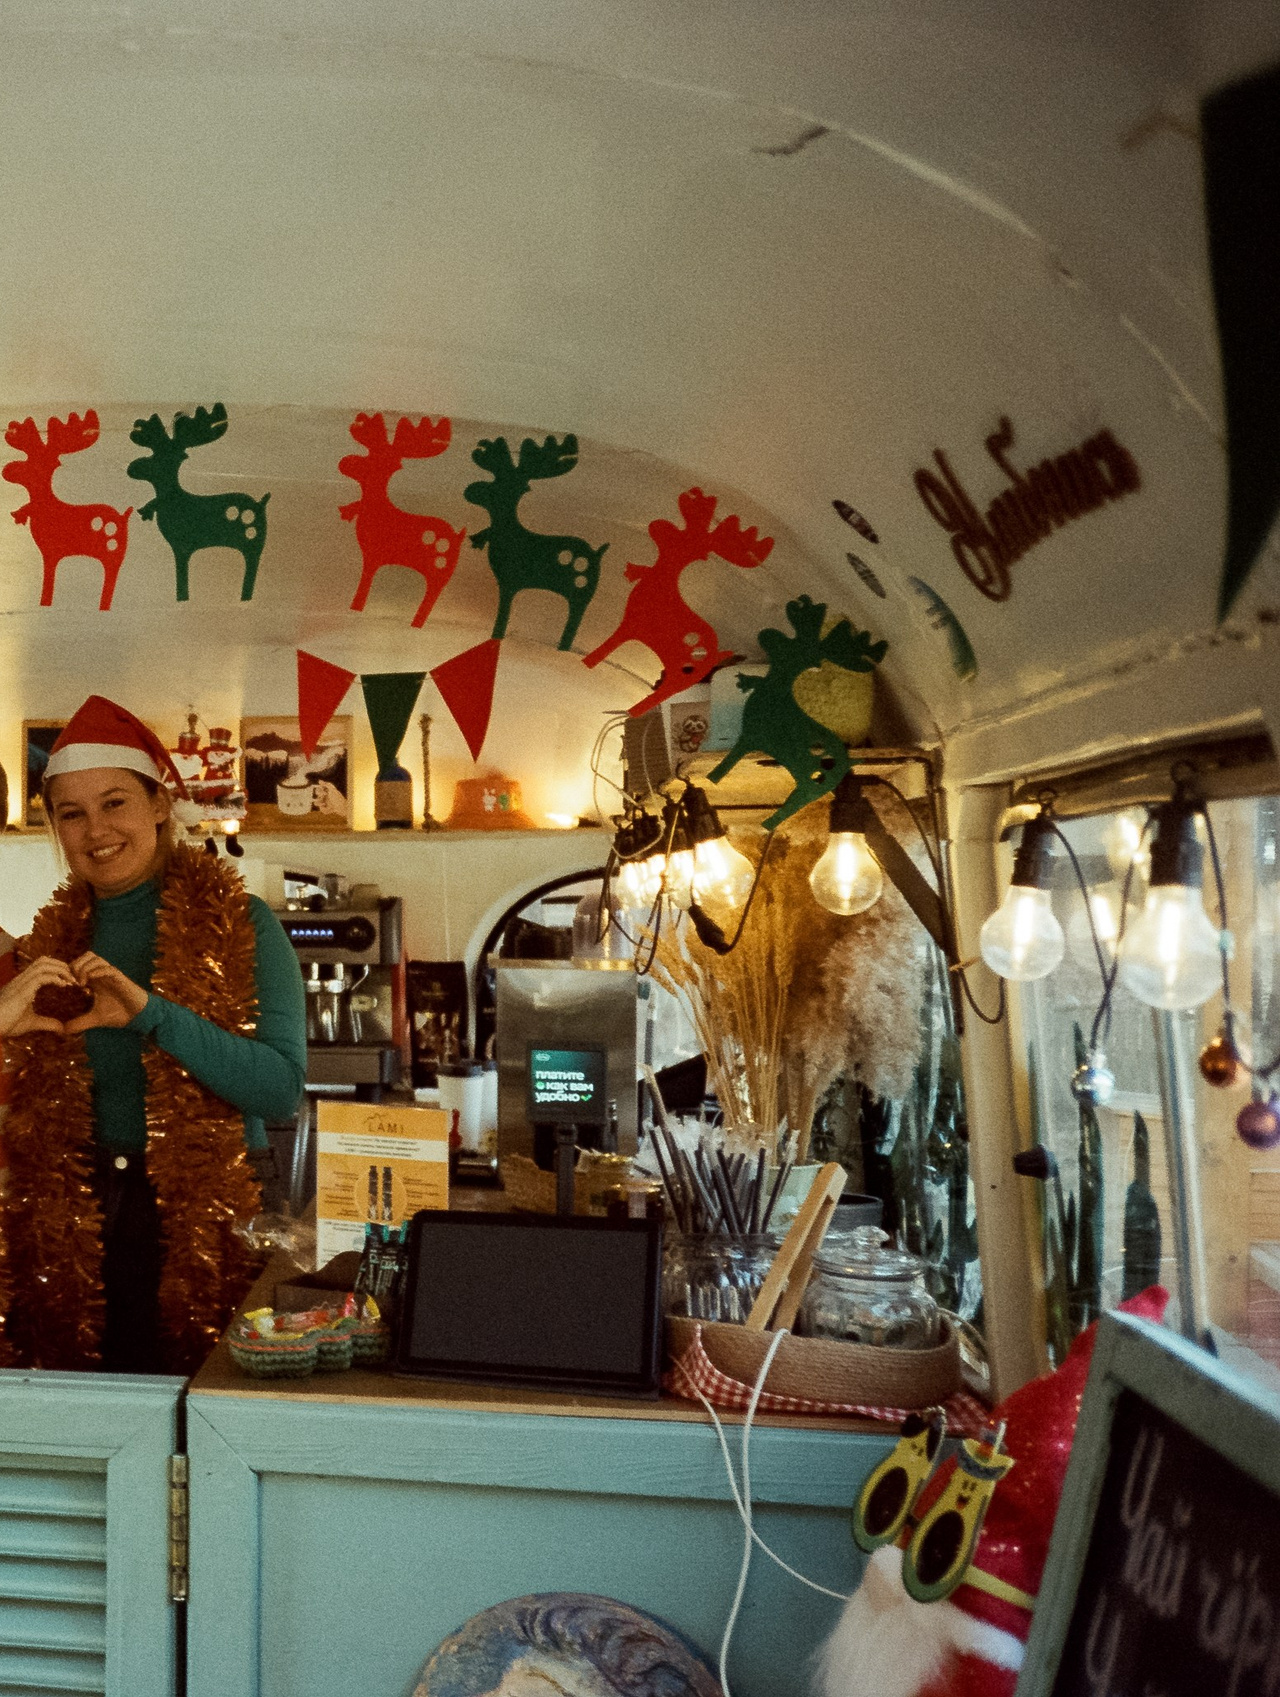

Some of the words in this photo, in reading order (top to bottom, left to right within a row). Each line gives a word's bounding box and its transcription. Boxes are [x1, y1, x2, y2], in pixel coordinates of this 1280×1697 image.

[535, 1070, 585, 1081] платите
[546, 1081, 569, 1091] как
[569, 1082, 594, 1092] вам
[535, 1090, 581, 1103] удобно
